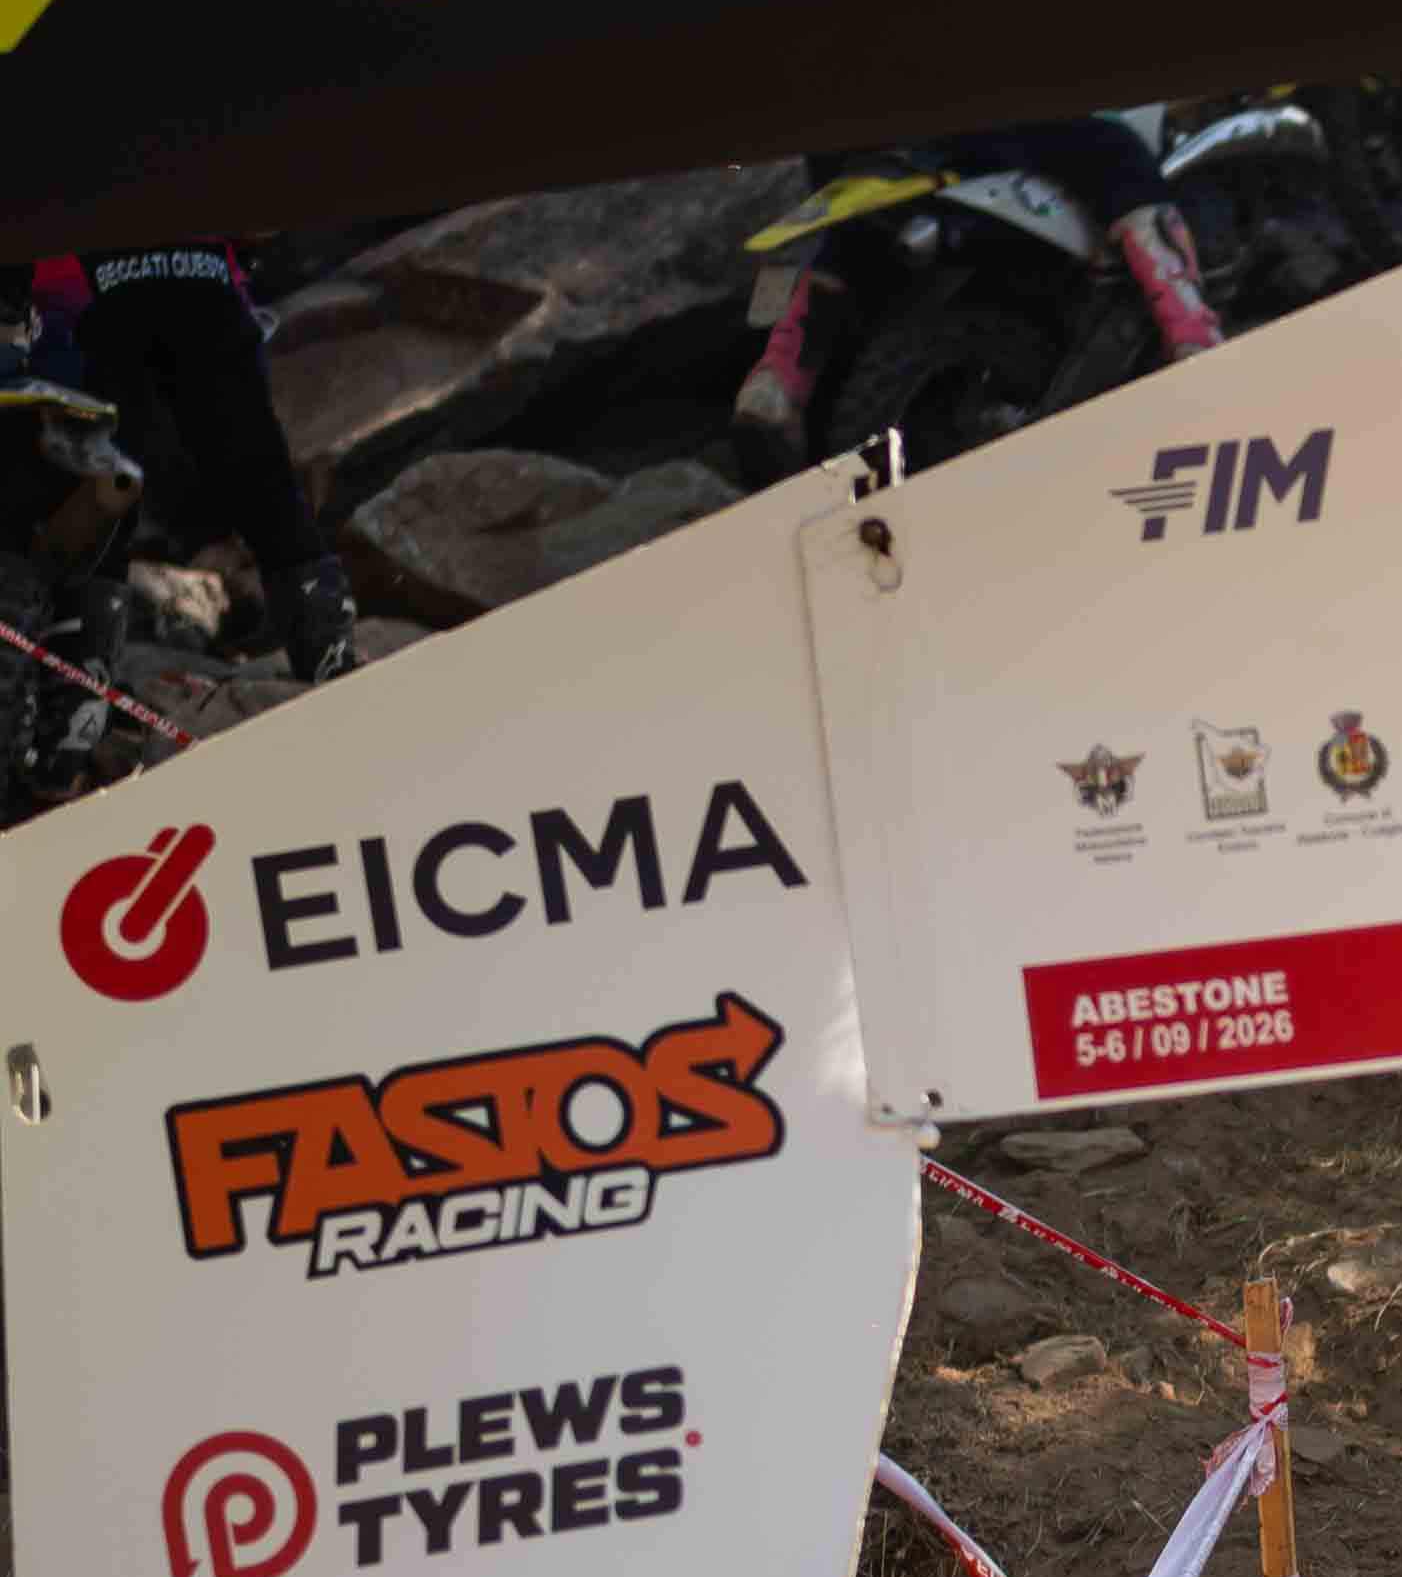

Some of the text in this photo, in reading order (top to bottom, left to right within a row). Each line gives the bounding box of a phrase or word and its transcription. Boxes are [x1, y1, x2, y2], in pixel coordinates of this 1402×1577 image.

[1109, 428, 1335, 543] FIM
[251, 780, 809, 972] EICMA
[1071, 970, 1290, 1028] ABESTONE
[1075, 1029, 1127, 1067] 5-6
[1151, 1022, 1191, 1058] 09
[1217, 1010, 1295, 1050] 2026
[165, 992, 784, 1260] FASTOS
[307, 1166, 657, 1279] RACING
[336, 1365, 686, 1487] PLEWS
[337, 1448, 684, 1568] TYRES
